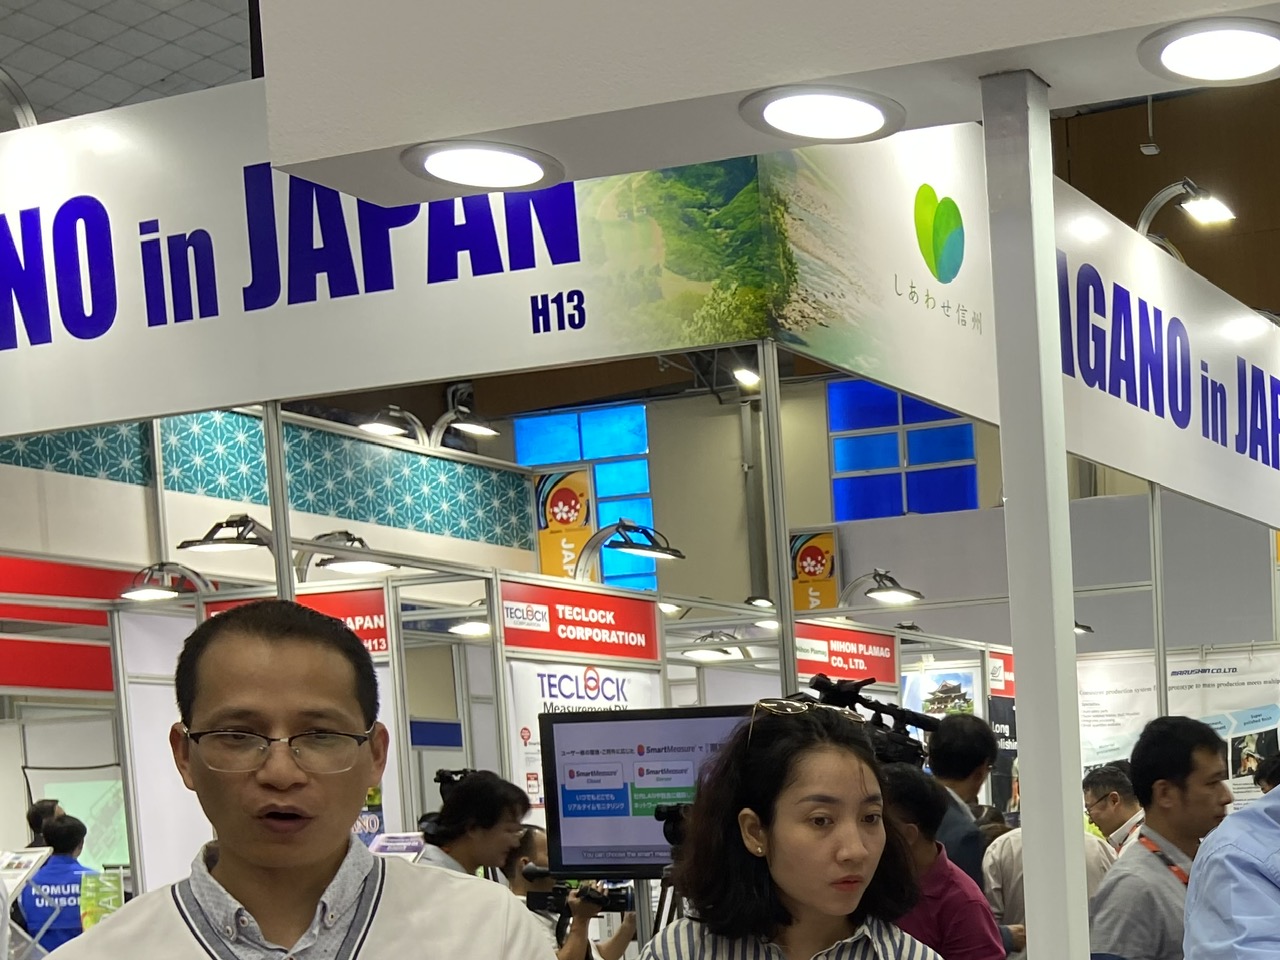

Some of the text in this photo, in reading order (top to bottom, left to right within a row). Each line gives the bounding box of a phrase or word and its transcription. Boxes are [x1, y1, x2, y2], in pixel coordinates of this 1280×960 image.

[139, 218, 220, 328] in
[242, 161, 581, 311] JAPAN
[530, 289, 587, 335] H13
[893, 272, 984, 336] しあわせ信州
[1200, 360, 1228, 449] in
[341, 614, 385, 631] APAN
[504, 604, 549, 622] TECLOCK
[555, 604, 616, 625] TECLOCK
[557, 623, 646, 647] CORPORATION
[829, 639, 891, 658] NIHON PLAMAG
[849, 658, 867, 671] LTD.
[537, 667, 629, 702] TECLOCK
